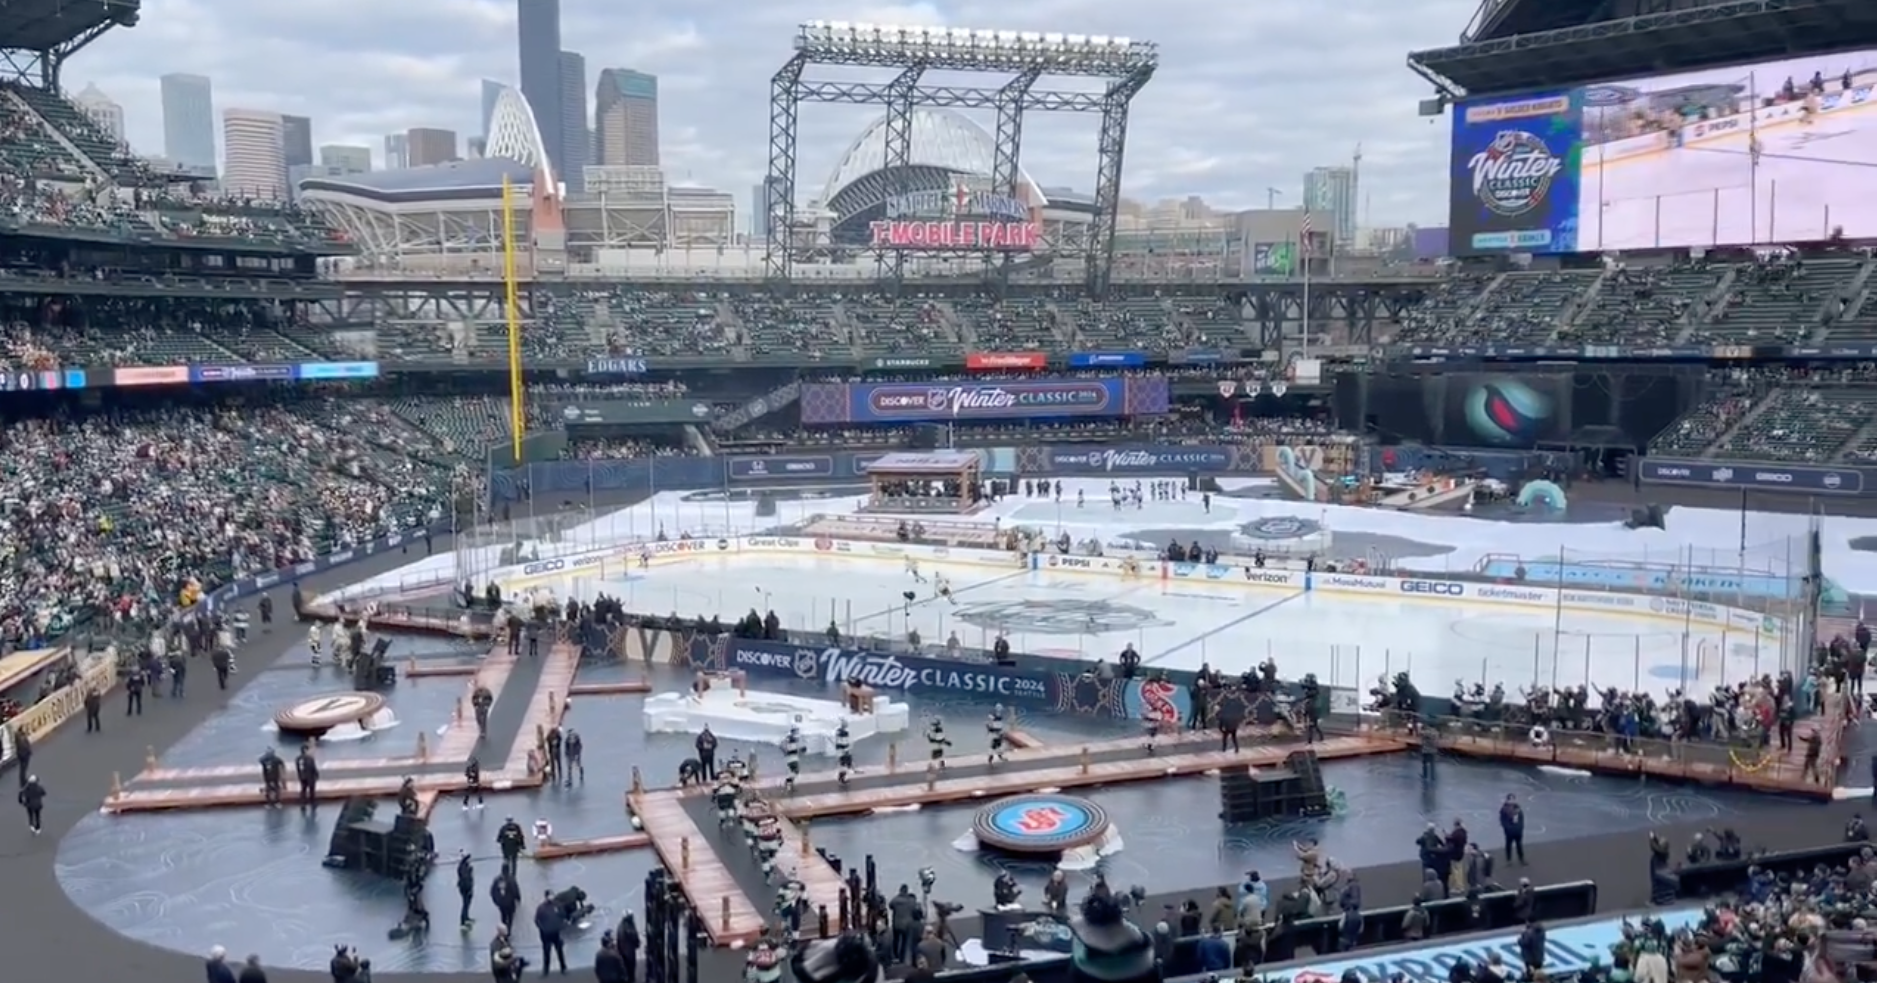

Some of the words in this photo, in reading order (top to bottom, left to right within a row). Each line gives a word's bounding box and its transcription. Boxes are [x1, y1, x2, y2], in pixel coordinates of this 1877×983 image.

[1467, 150, 1562, 196] Winter
[1489, 178, 1538, 190] CLASSIC
[869, 220, 976, 246] T-MOBILE
[978, 221, 1038, 248] PARK
[880, 396, 925, 406] DISCOVER
[948, 386, 1017, 418] Winter
[1019, 391, 1077, 404] CLASSIC
[1103, 449, 1157, 471] Winter
[1159, 453, 1208, 463] CLASSIC
[655, 540, 706, 552] DISCOVER
[523, 559, 565, 577] GEICO
[1061, 557, 1091, 568] PEPSI
[1246, 570, 1289, 584] verizon
[1399, 580, 1464, 596] GEICO
[1477, 586, 1544, 600] ticketmaster
[736, 650, 791, 669] DISCOVER
[820, 648, 921, 690] Winter
[920, 667, 1011, 696] CLASSIC
[1013, 678, 1047, 692] 2024
